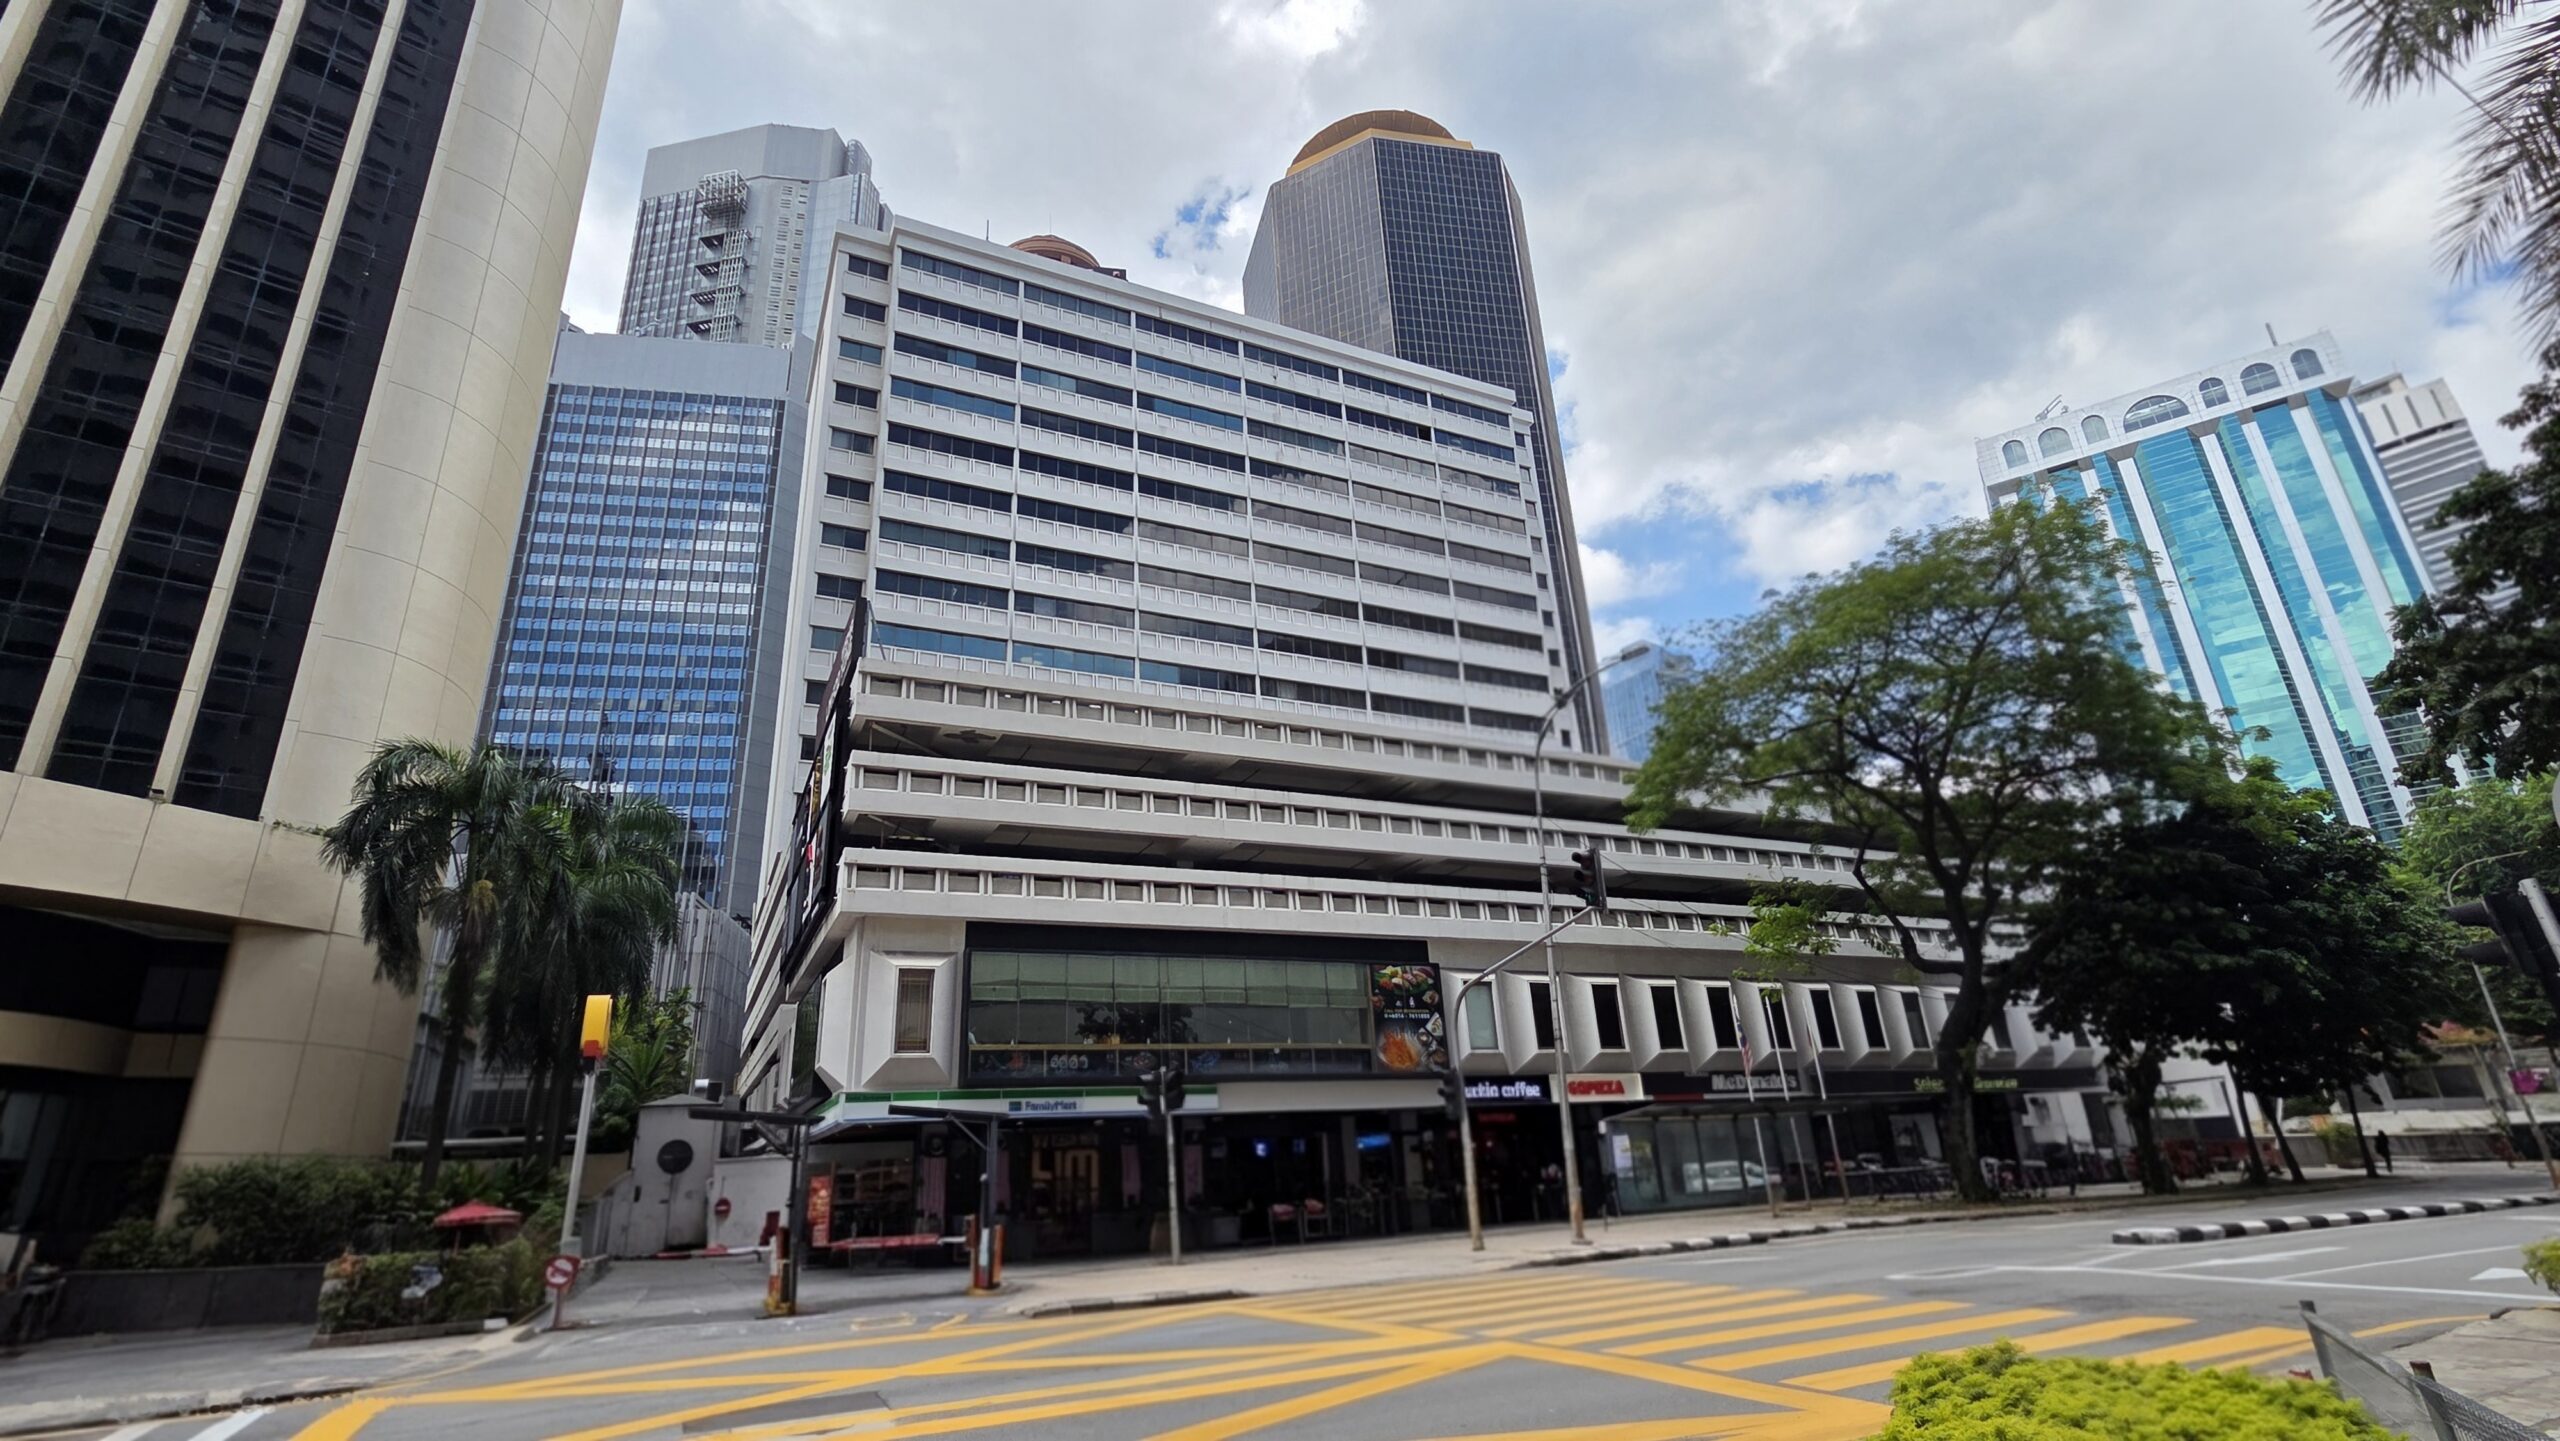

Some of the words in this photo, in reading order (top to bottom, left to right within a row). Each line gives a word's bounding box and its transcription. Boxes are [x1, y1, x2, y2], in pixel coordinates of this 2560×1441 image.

[1463, 1082, 1499, 1098] uckin
[1501, 1081, 1541, 1098] coffee
[1024, 1100, 1077, 1112] FamilyMart
